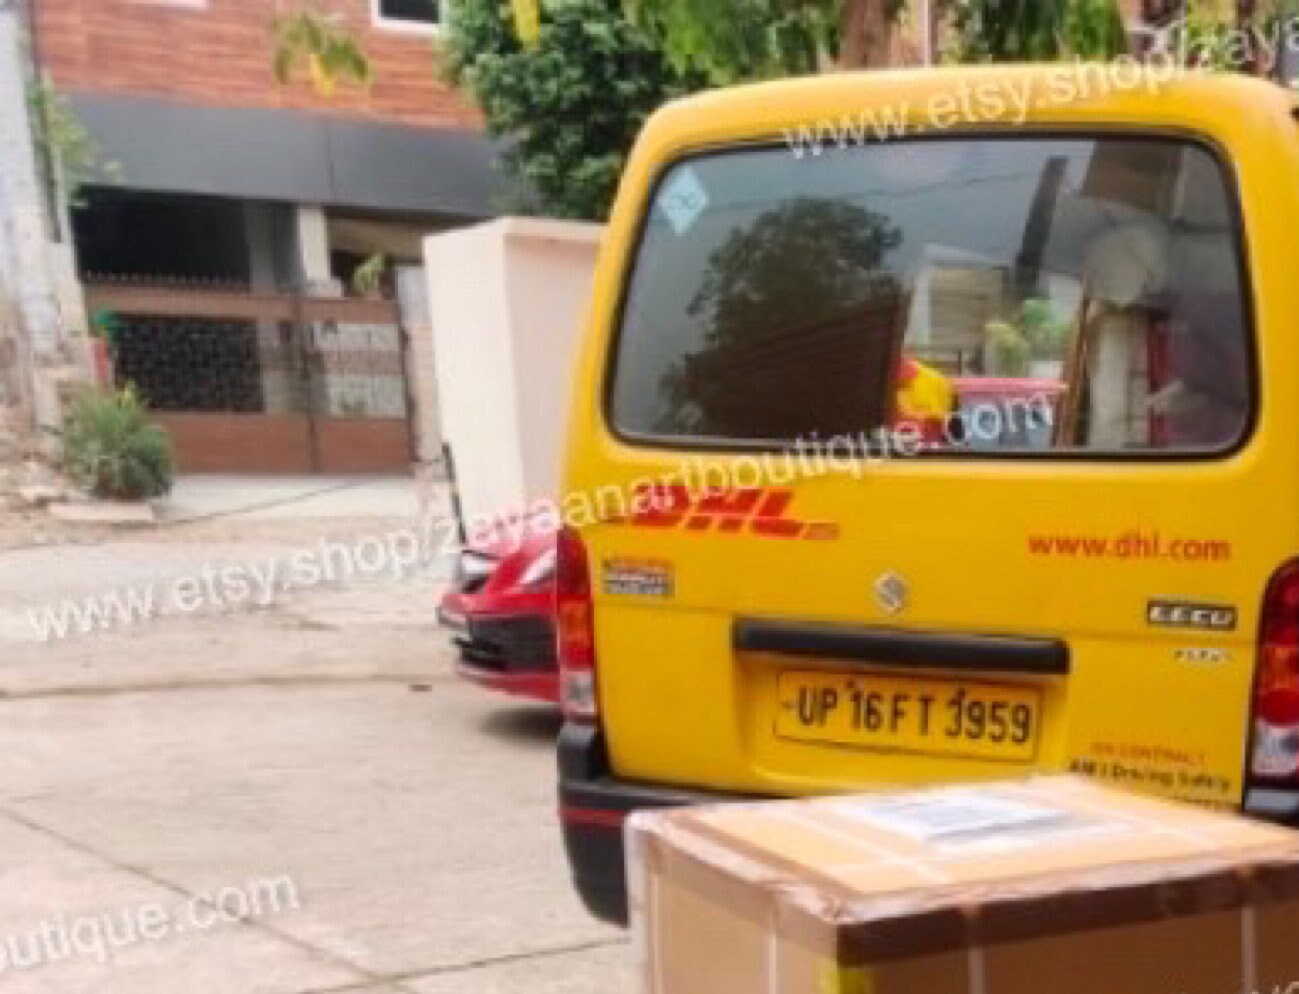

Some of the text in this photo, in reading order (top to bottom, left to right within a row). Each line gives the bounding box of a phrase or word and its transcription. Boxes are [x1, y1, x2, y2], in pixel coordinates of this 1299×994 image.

[628, 484, 806, 540] DHL
[1027, 526, 1233, 561] www.dhl.com
[798, 685, 838, 727] UP
